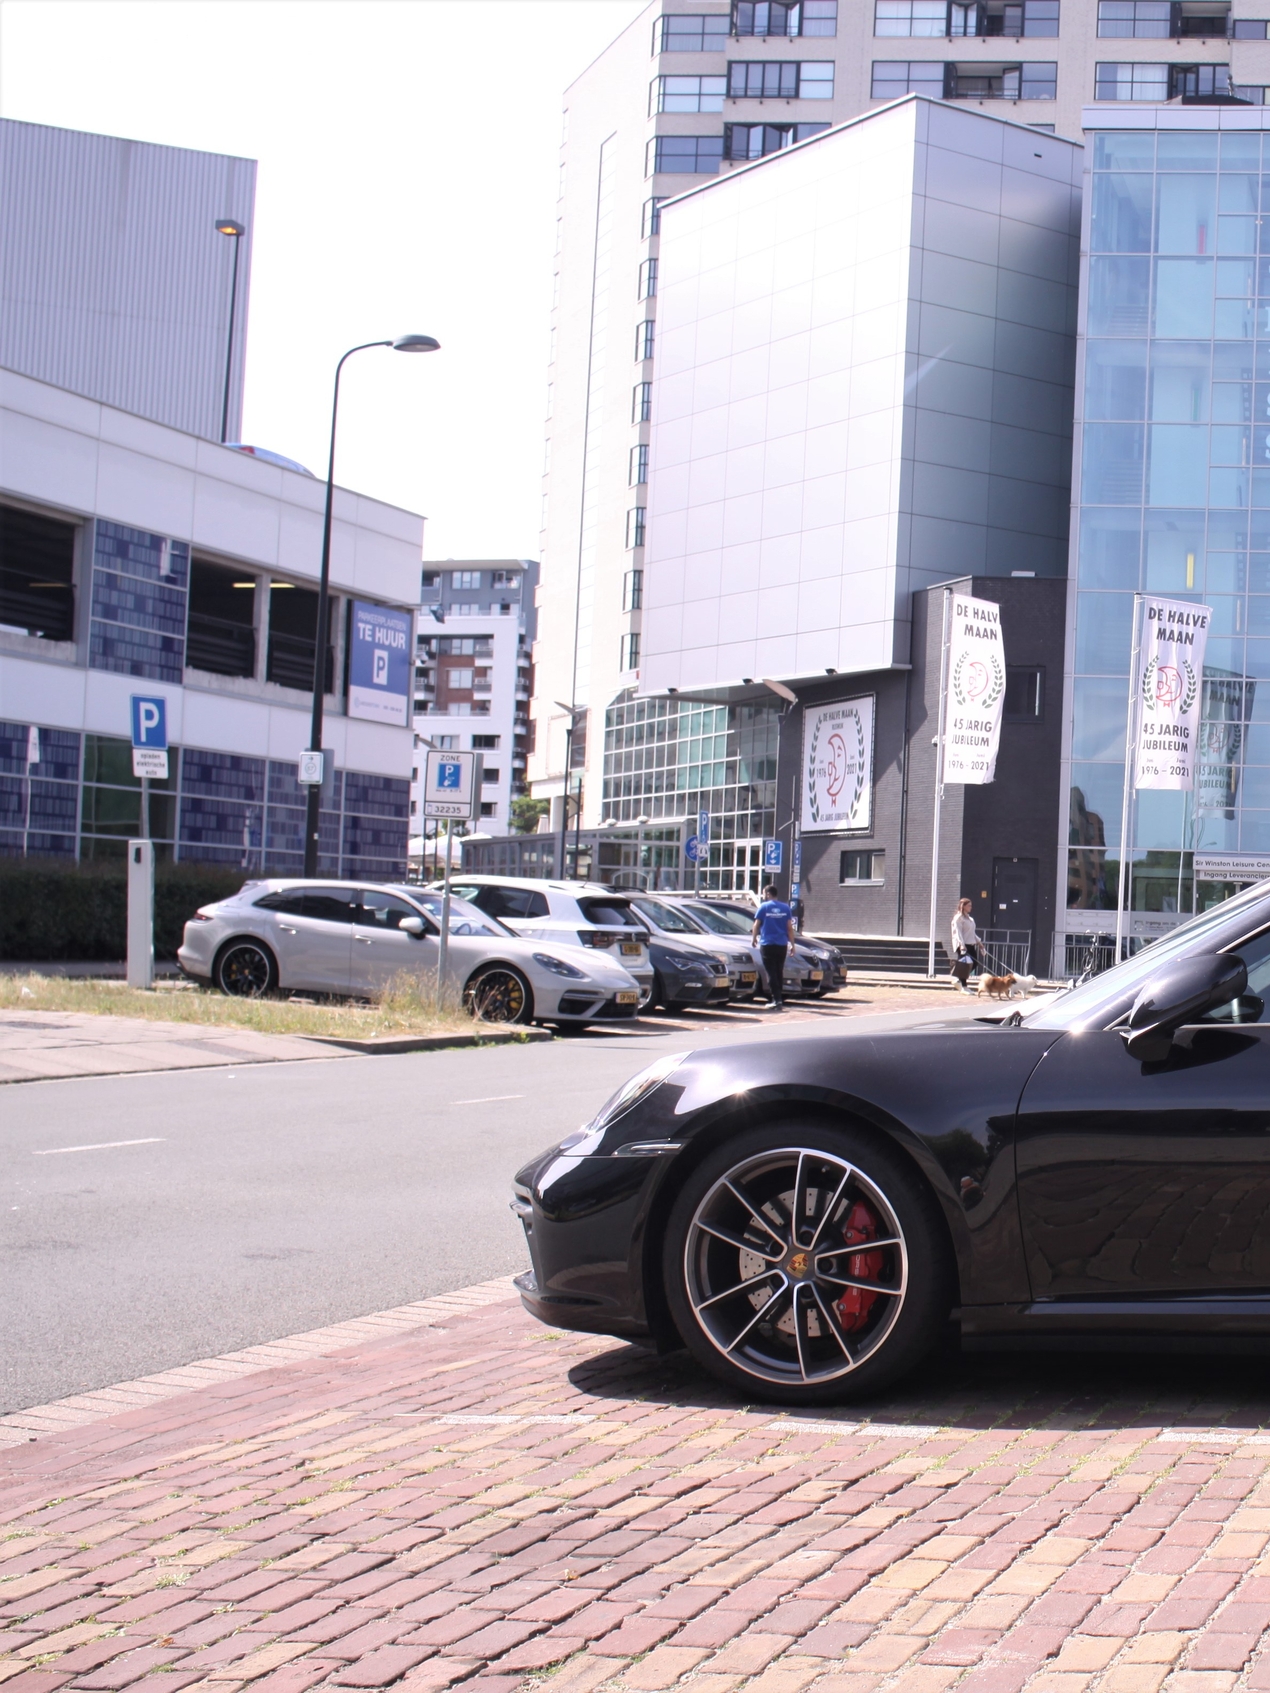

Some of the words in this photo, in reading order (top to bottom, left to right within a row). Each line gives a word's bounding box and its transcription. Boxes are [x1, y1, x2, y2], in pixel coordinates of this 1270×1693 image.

[956, 603, 969, 617] DE
[1148, 606, 1164, 622] DE
[1167, 609, 1208, 629] HALVE
[358, 622, 373, 642] TE
[375, 626, 406, 650] HUUR
[964, 623, 998, 641] MAAN
[1156, 627, 1195, 646] MAAN
[376, 655, 386, 678] P
[139, 701, 160, 742] P
[822, 712, 829, 722] DE
[828, 710, 841, 721] HALVE
[841, 708, 854, 718] MAAN
[953, 718, 964, 730] 45
[965, 719, 993, 733] JARIG
[1143, 723, 1156, 737] 45
[1157, 723, 1190, 738] JARIG
[951, 733, 990, 748] JUBILEUM
[1142, 739, 1189, 753] JUBILEUM
[445, 765, 454, 777] P
[846, 763, 857, 775] 2021
[948, 760, 964, 770] 1976
[971, 760, 989, 771] 2021
[1142, 765, 1159, 776] 1976
[1169, 765, 1189, 777] 2021
[434, 805, 462, 814] 32235
[702, 814, 707, 830] P
[767, 843, 776, 854] P
[1204, 871, 1228, 879] Ingang
